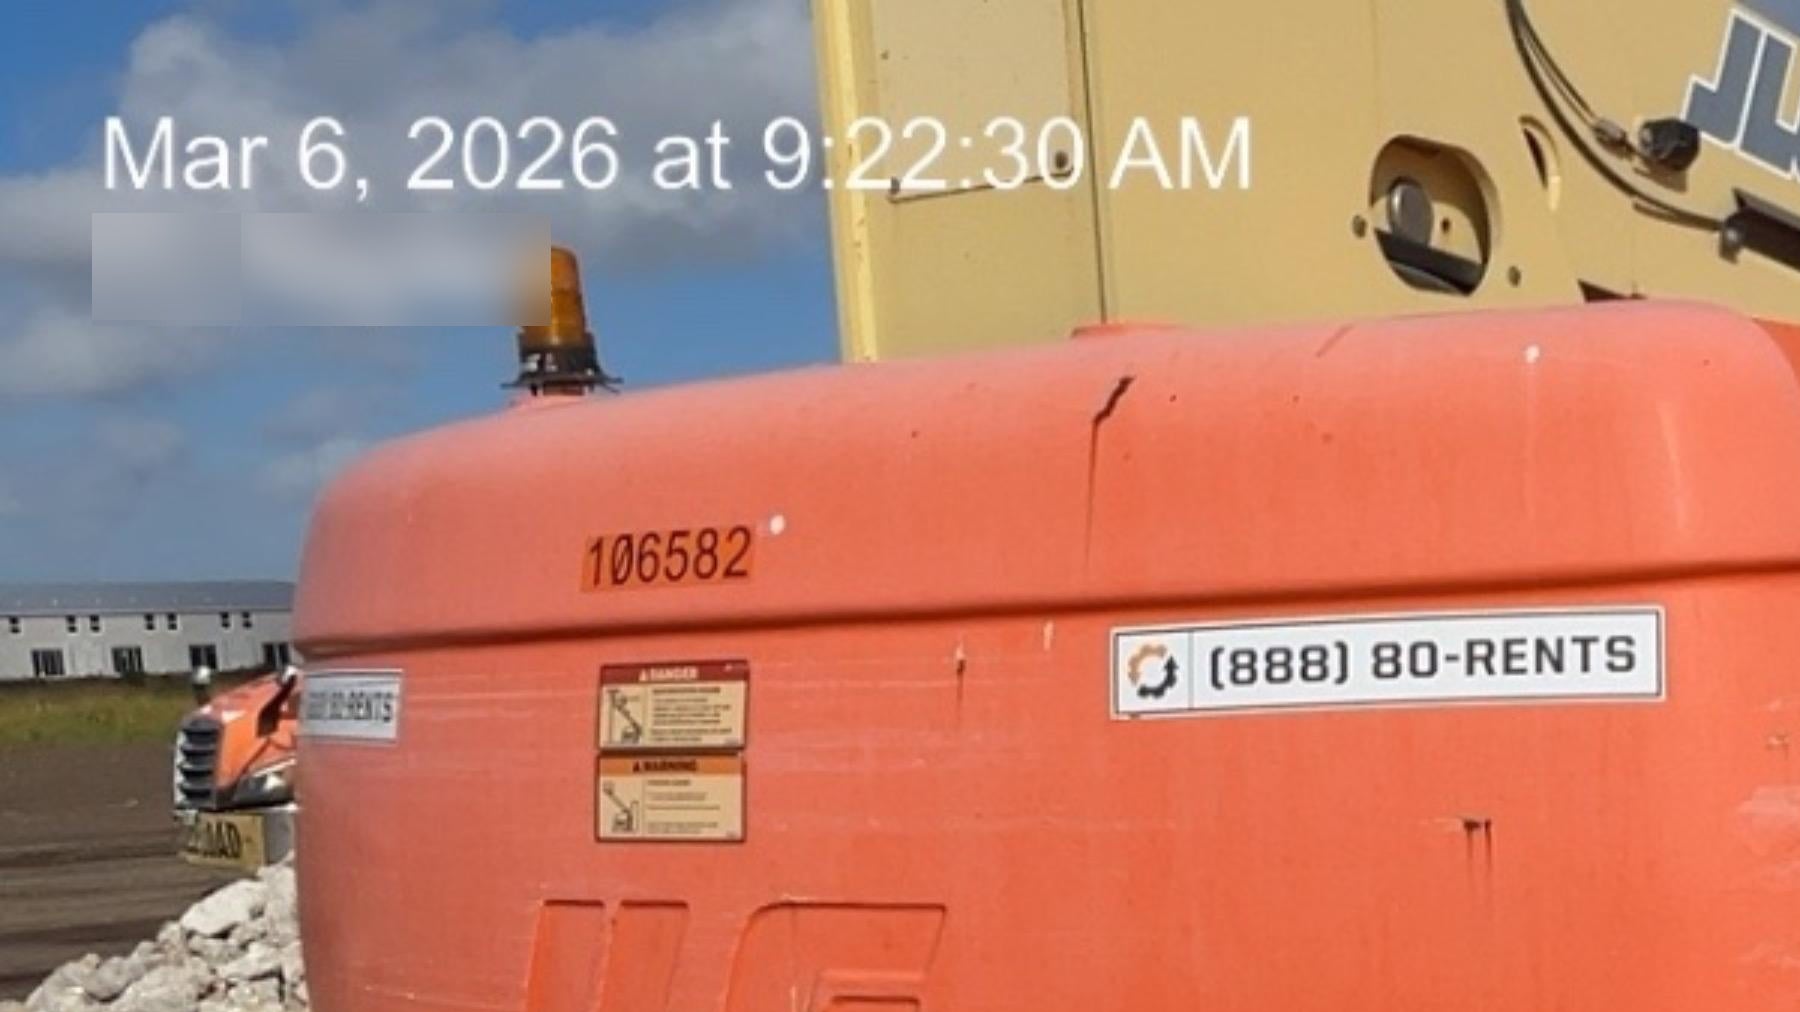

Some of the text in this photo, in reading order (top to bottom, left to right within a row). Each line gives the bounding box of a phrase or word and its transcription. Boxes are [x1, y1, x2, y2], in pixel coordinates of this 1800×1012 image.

[588, 525, 752, 588] 106582
[1210, 634, 1638, 690] (888) 80-RENTS
